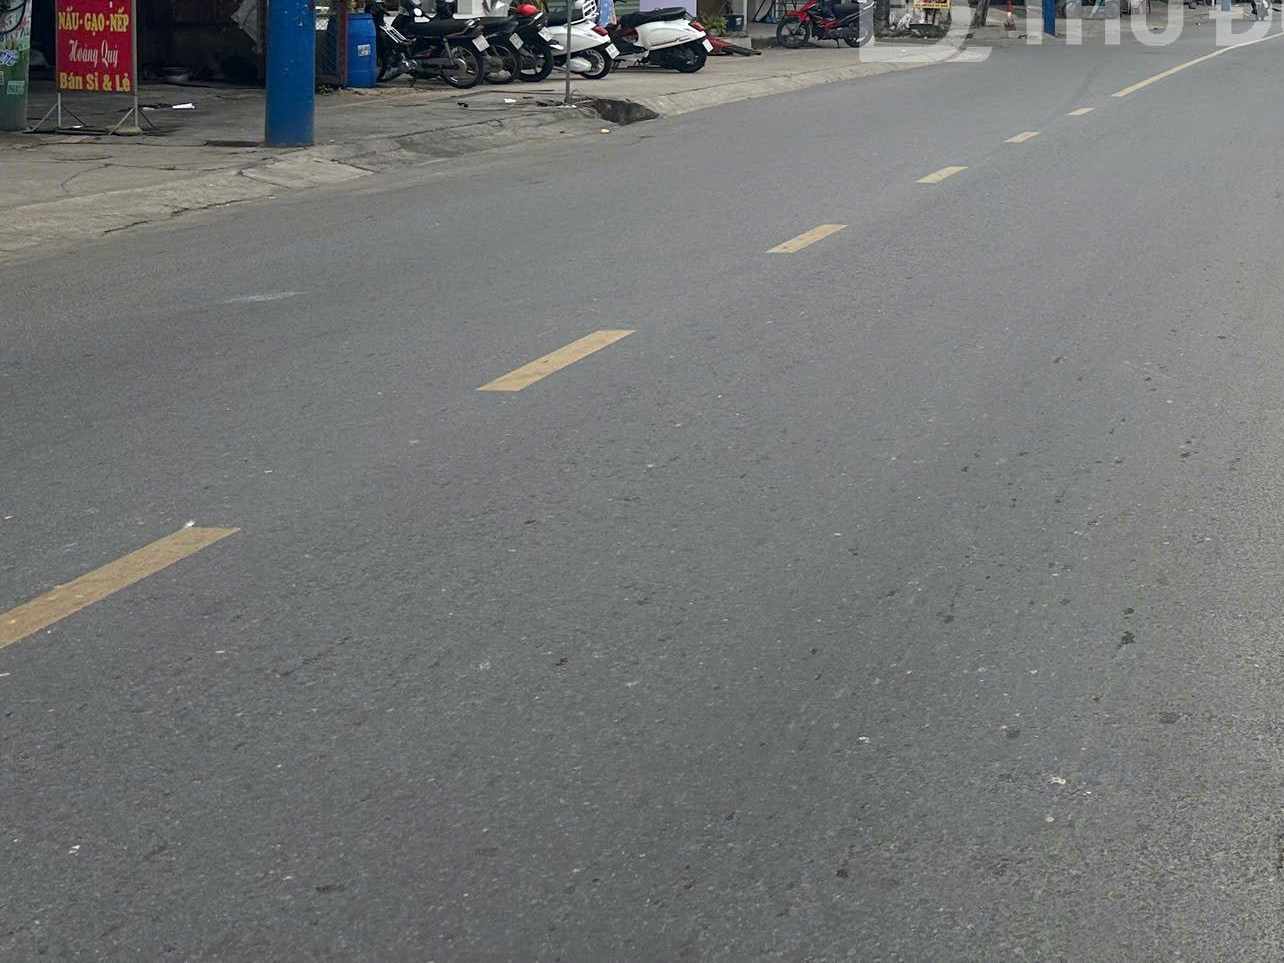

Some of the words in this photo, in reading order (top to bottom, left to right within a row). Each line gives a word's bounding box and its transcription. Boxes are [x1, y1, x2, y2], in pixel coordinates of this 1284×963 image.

[68, 39, 99, 68] Hoàng
[59, 71, 83, 90] Bán
[102, 74, 112, 91] &
